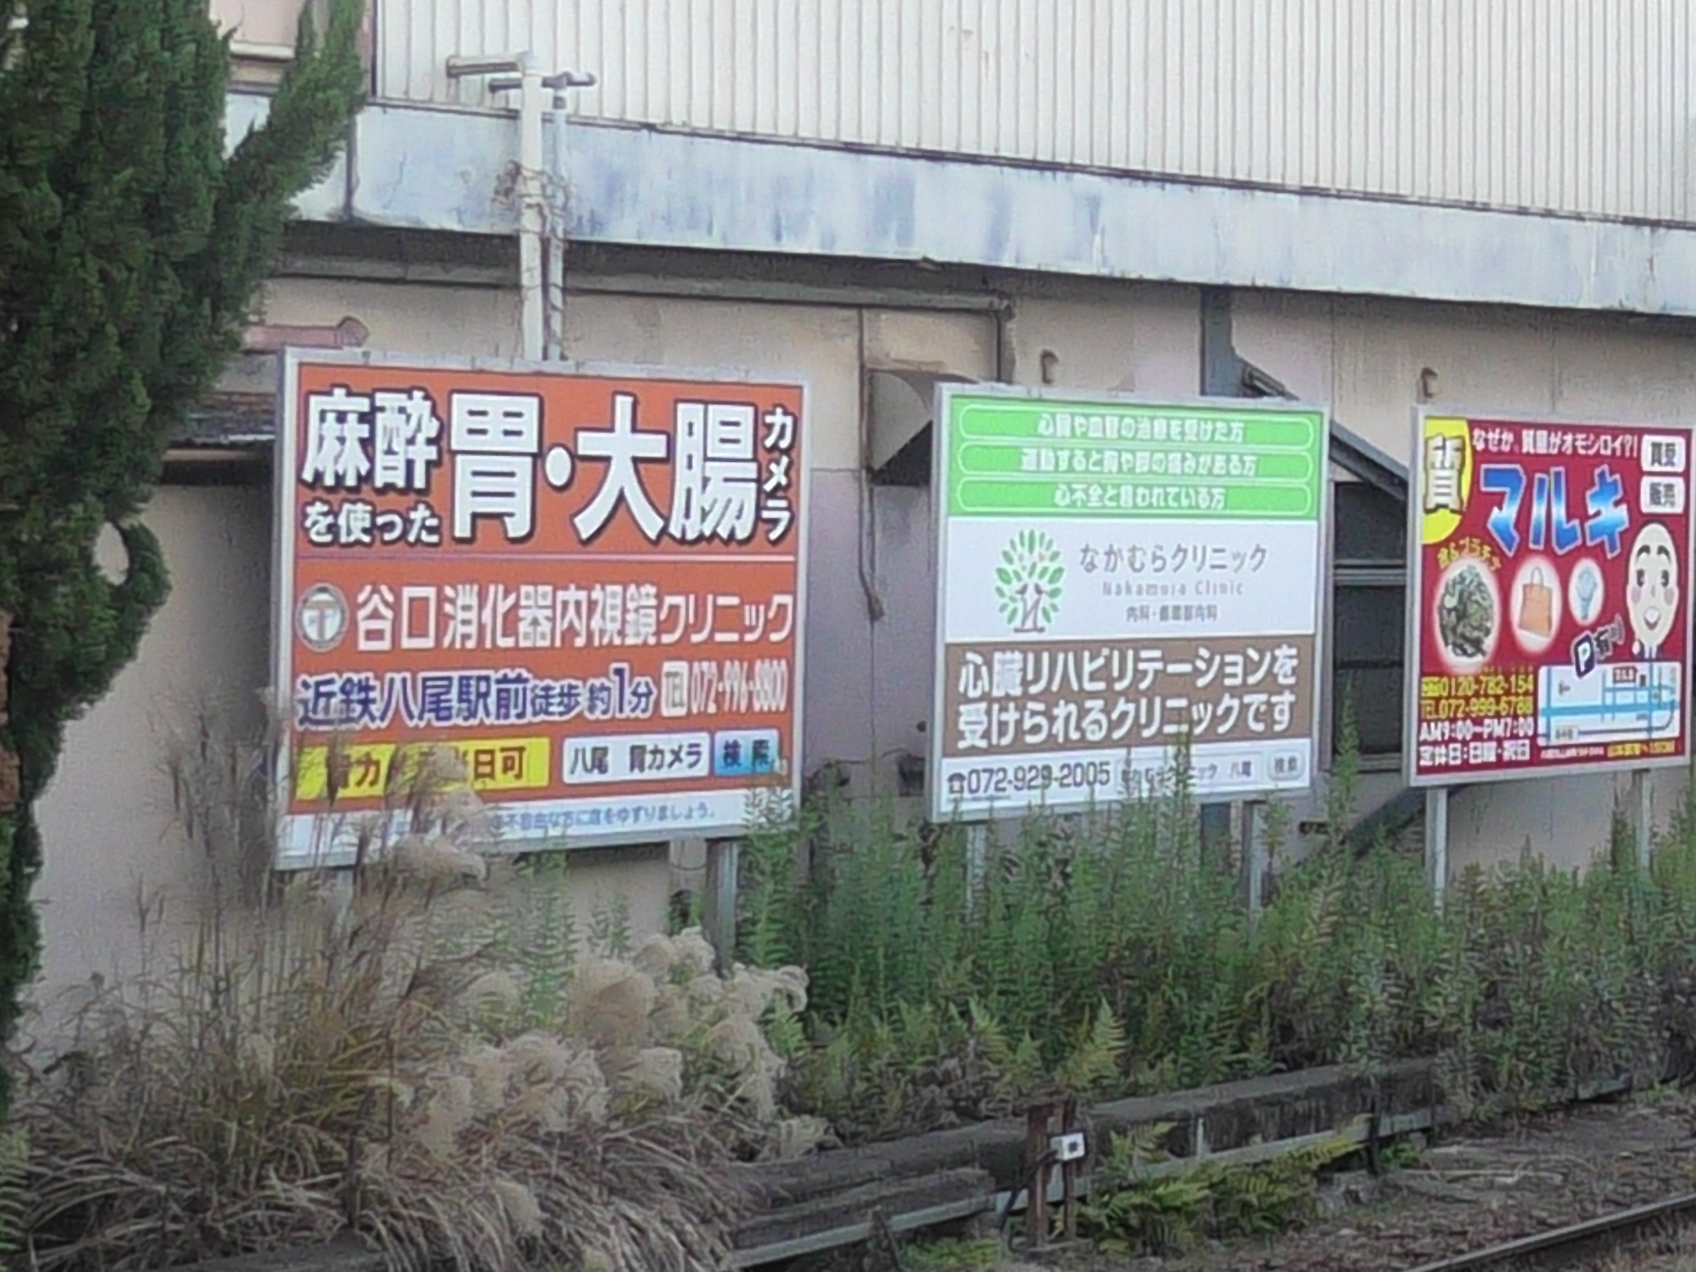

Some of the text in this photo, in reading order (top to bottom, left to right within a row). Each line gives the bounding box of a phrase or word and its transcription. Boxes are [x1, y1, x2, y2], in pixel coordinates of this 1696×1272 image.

[302, 386, 441, 490] 麻酔
[760, 405, 796, 543] カメラ
[303, 499, 441, 545] を使った
[1479, 462, 1631, 560] マルキ
[1079, 542, 1268, 575] なかむらクリニック
[1194, 578, 1246, 597] Clinic
[356, 582, 794, 653] 谷口消化器内視鏡クリニック
[957, 643, 1300, 700] 心臓リハビリテーションを
[956, 690, 1297, 750] 受けられるクリニックです
[629, 738, 704, 775] 胃カメラ
[723, 737, 771, 769] 検索
